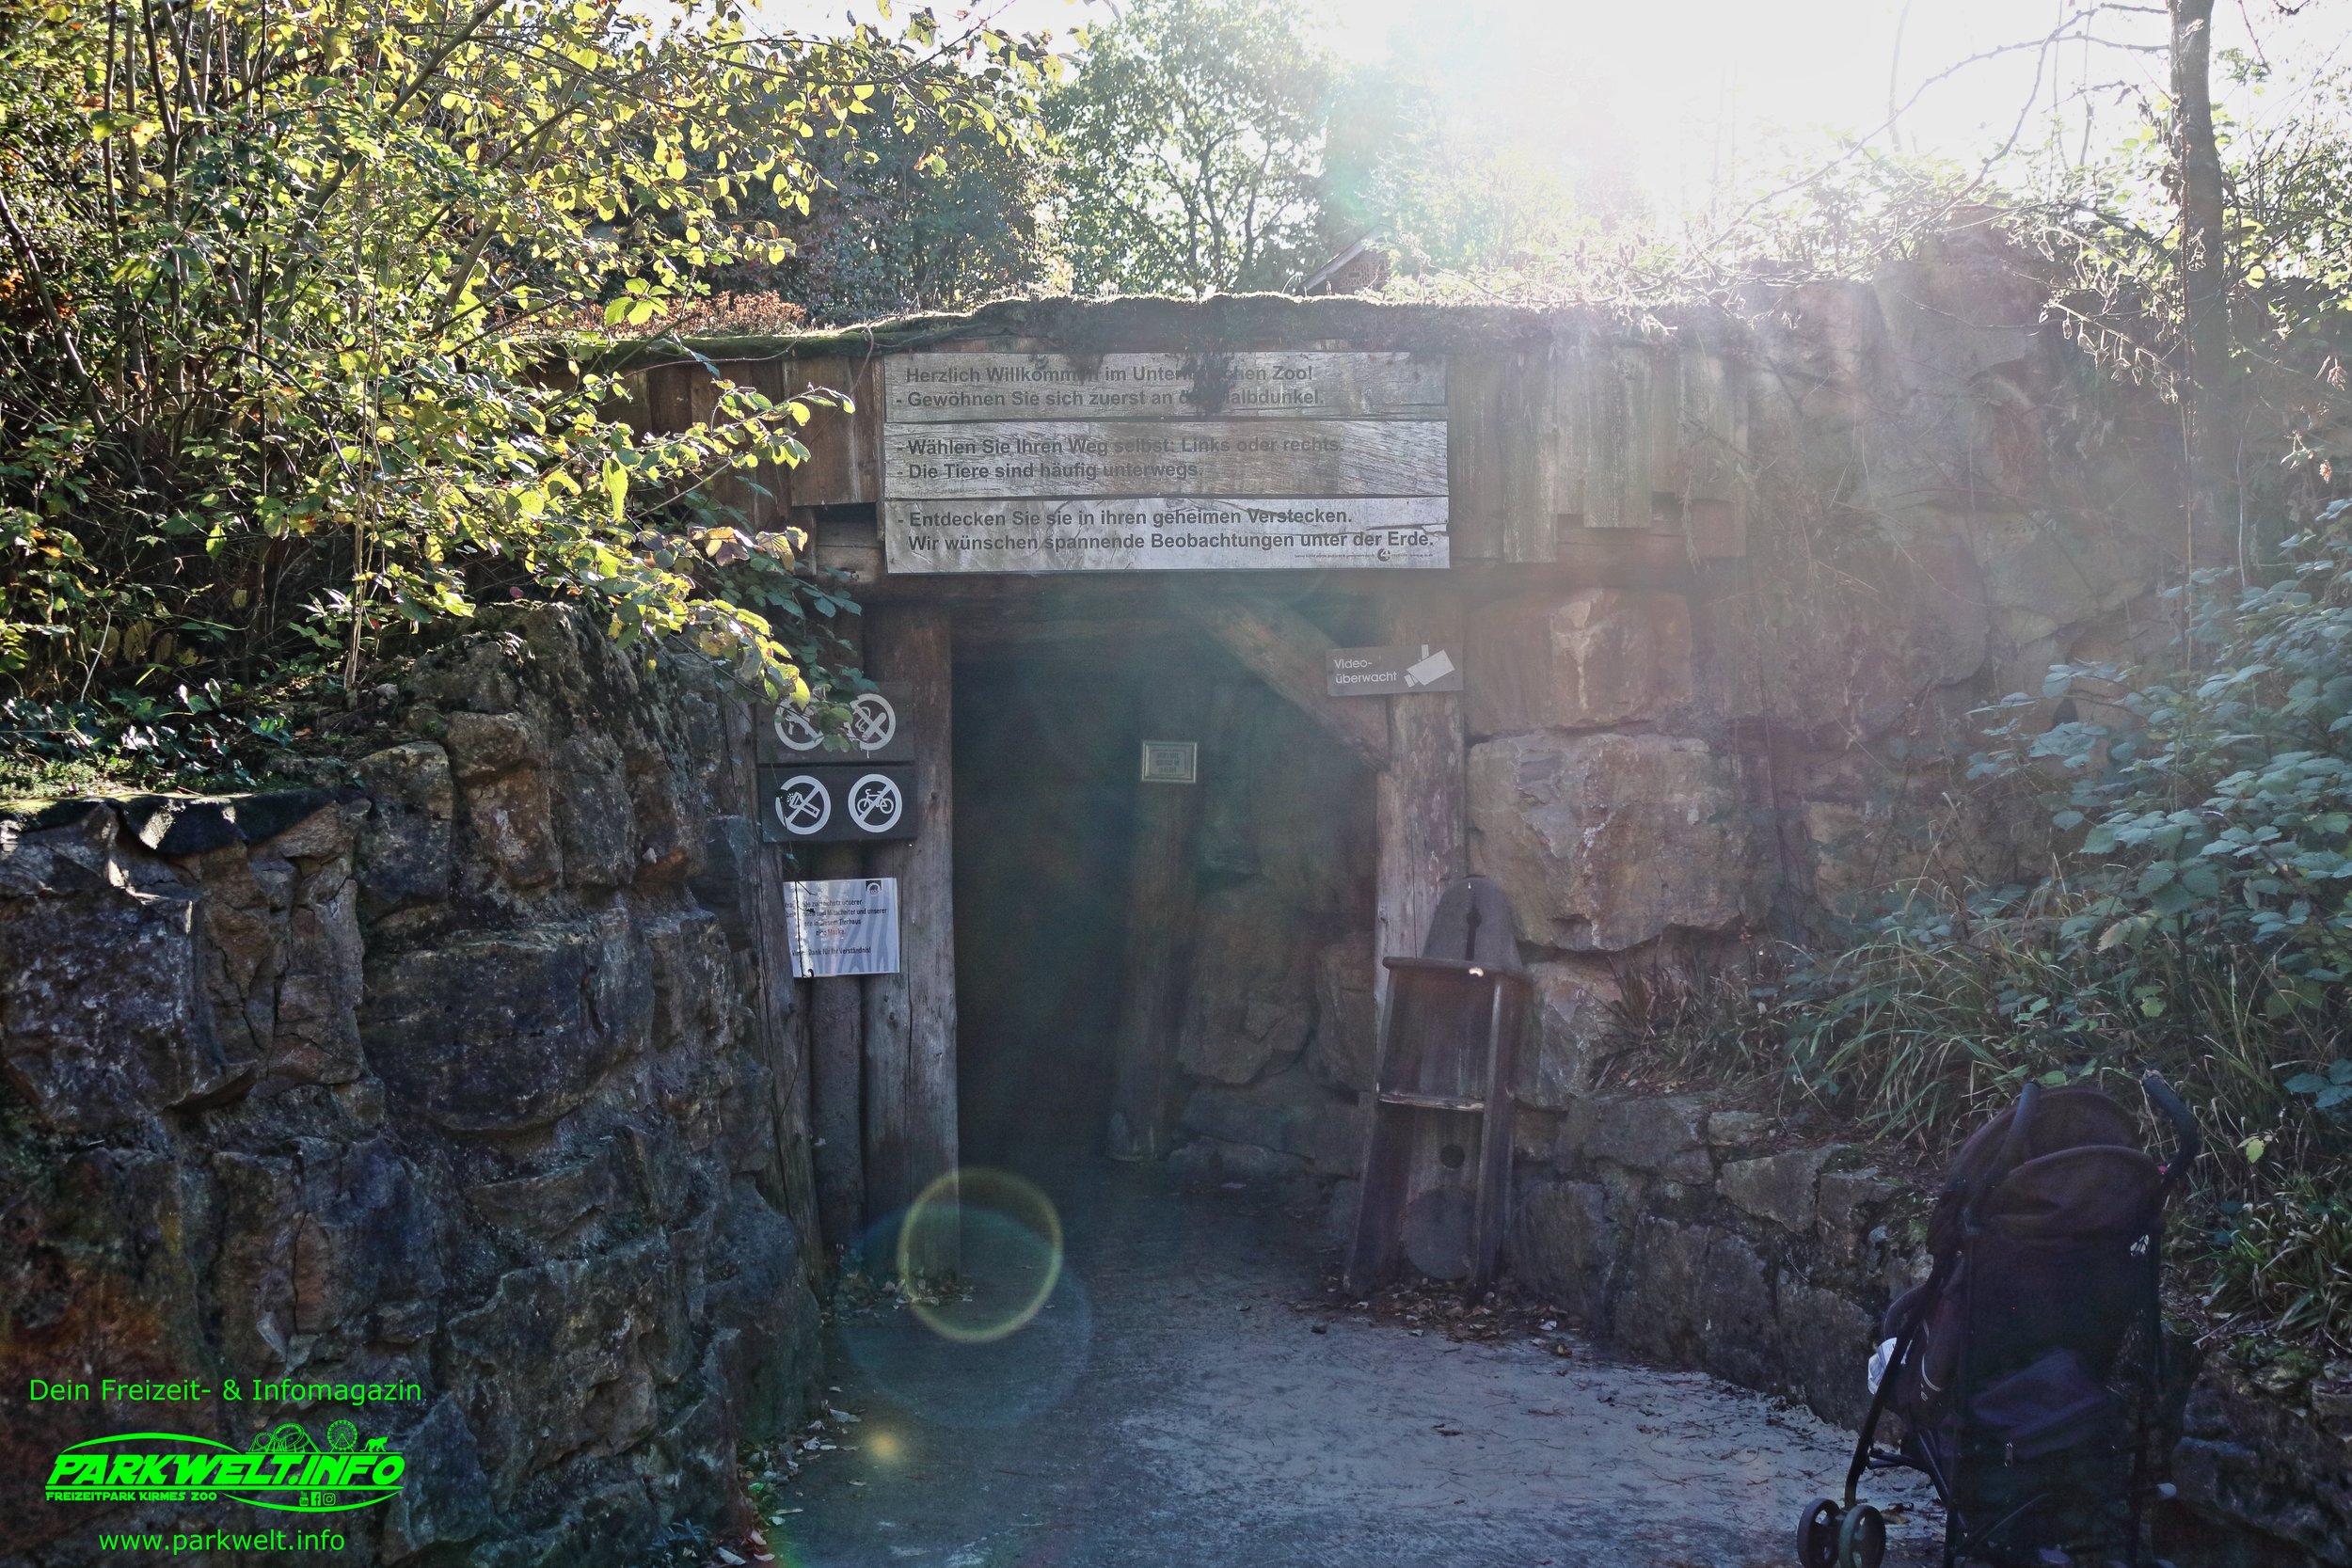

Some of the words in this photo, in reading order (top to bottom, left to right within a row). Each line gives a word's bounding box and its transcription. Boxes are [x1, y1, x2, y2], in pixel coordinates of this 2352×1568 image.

[906, 367, 980, 382] Herzlich
[987, 366, 1099, 382] Willkommn
[1105, 366, 1127, 381] im
[1272, 365, 1312, 380] Zoo!
[908, 390, 1006, 406] Gewöhnen
[1011, 390, 1040, 405] Sie
[1045, 390, 1082, 405] sich
[1089, 391, 1145, 405] zuerst
[1151, 394, 1173, 405] an
[908, 439, 976, 454] Wählen
[982, 439, 1010, 453] Sie
[1016, 439, 1062, 453] Ihren
[1067, 439, 1108, 456] Weg
[1182, 437, 1230, 452] Links
[1237, 437, 1279, 452] oder
[1282, 436, 1344, 451] rechts.
[909, 464, 938, 479] Die
[944, 464, 989, 478] Tiere
[994, 463, 1034, 478] sind
[1040, 463, 1097, 481] häufig
[1103, 462, 1202, 479] unterwegs.
[909, 511, 1006, 527] Entdecken
[1011, 511, 1040, 526] Sie
[1046, 511, 1073, 526] sie
[1079, 510, 1094, 525] in
[1101, 510, 1147, 525] ihren
[1152, 509, 1241, 528] geheimen
[1248, 508, 1353, 523] Verstecken.
[908, 536, 939, 550] Wir
[945, 535, 1041, 550] wünschen
[1044, 533, 1144, 552] spannende
[1151, 532, 1295, 550] Beobachtungen
[1300, 532, 1347, 547] unter
[1353, 531, 1382, 546] der
[1387, 531, 1434, 546] Erde.
[1334, 659, 1373, 669] Video-
[1335, 671, 1397, 684] überwacht
[839, 945, 872, 954] Verständnis!
